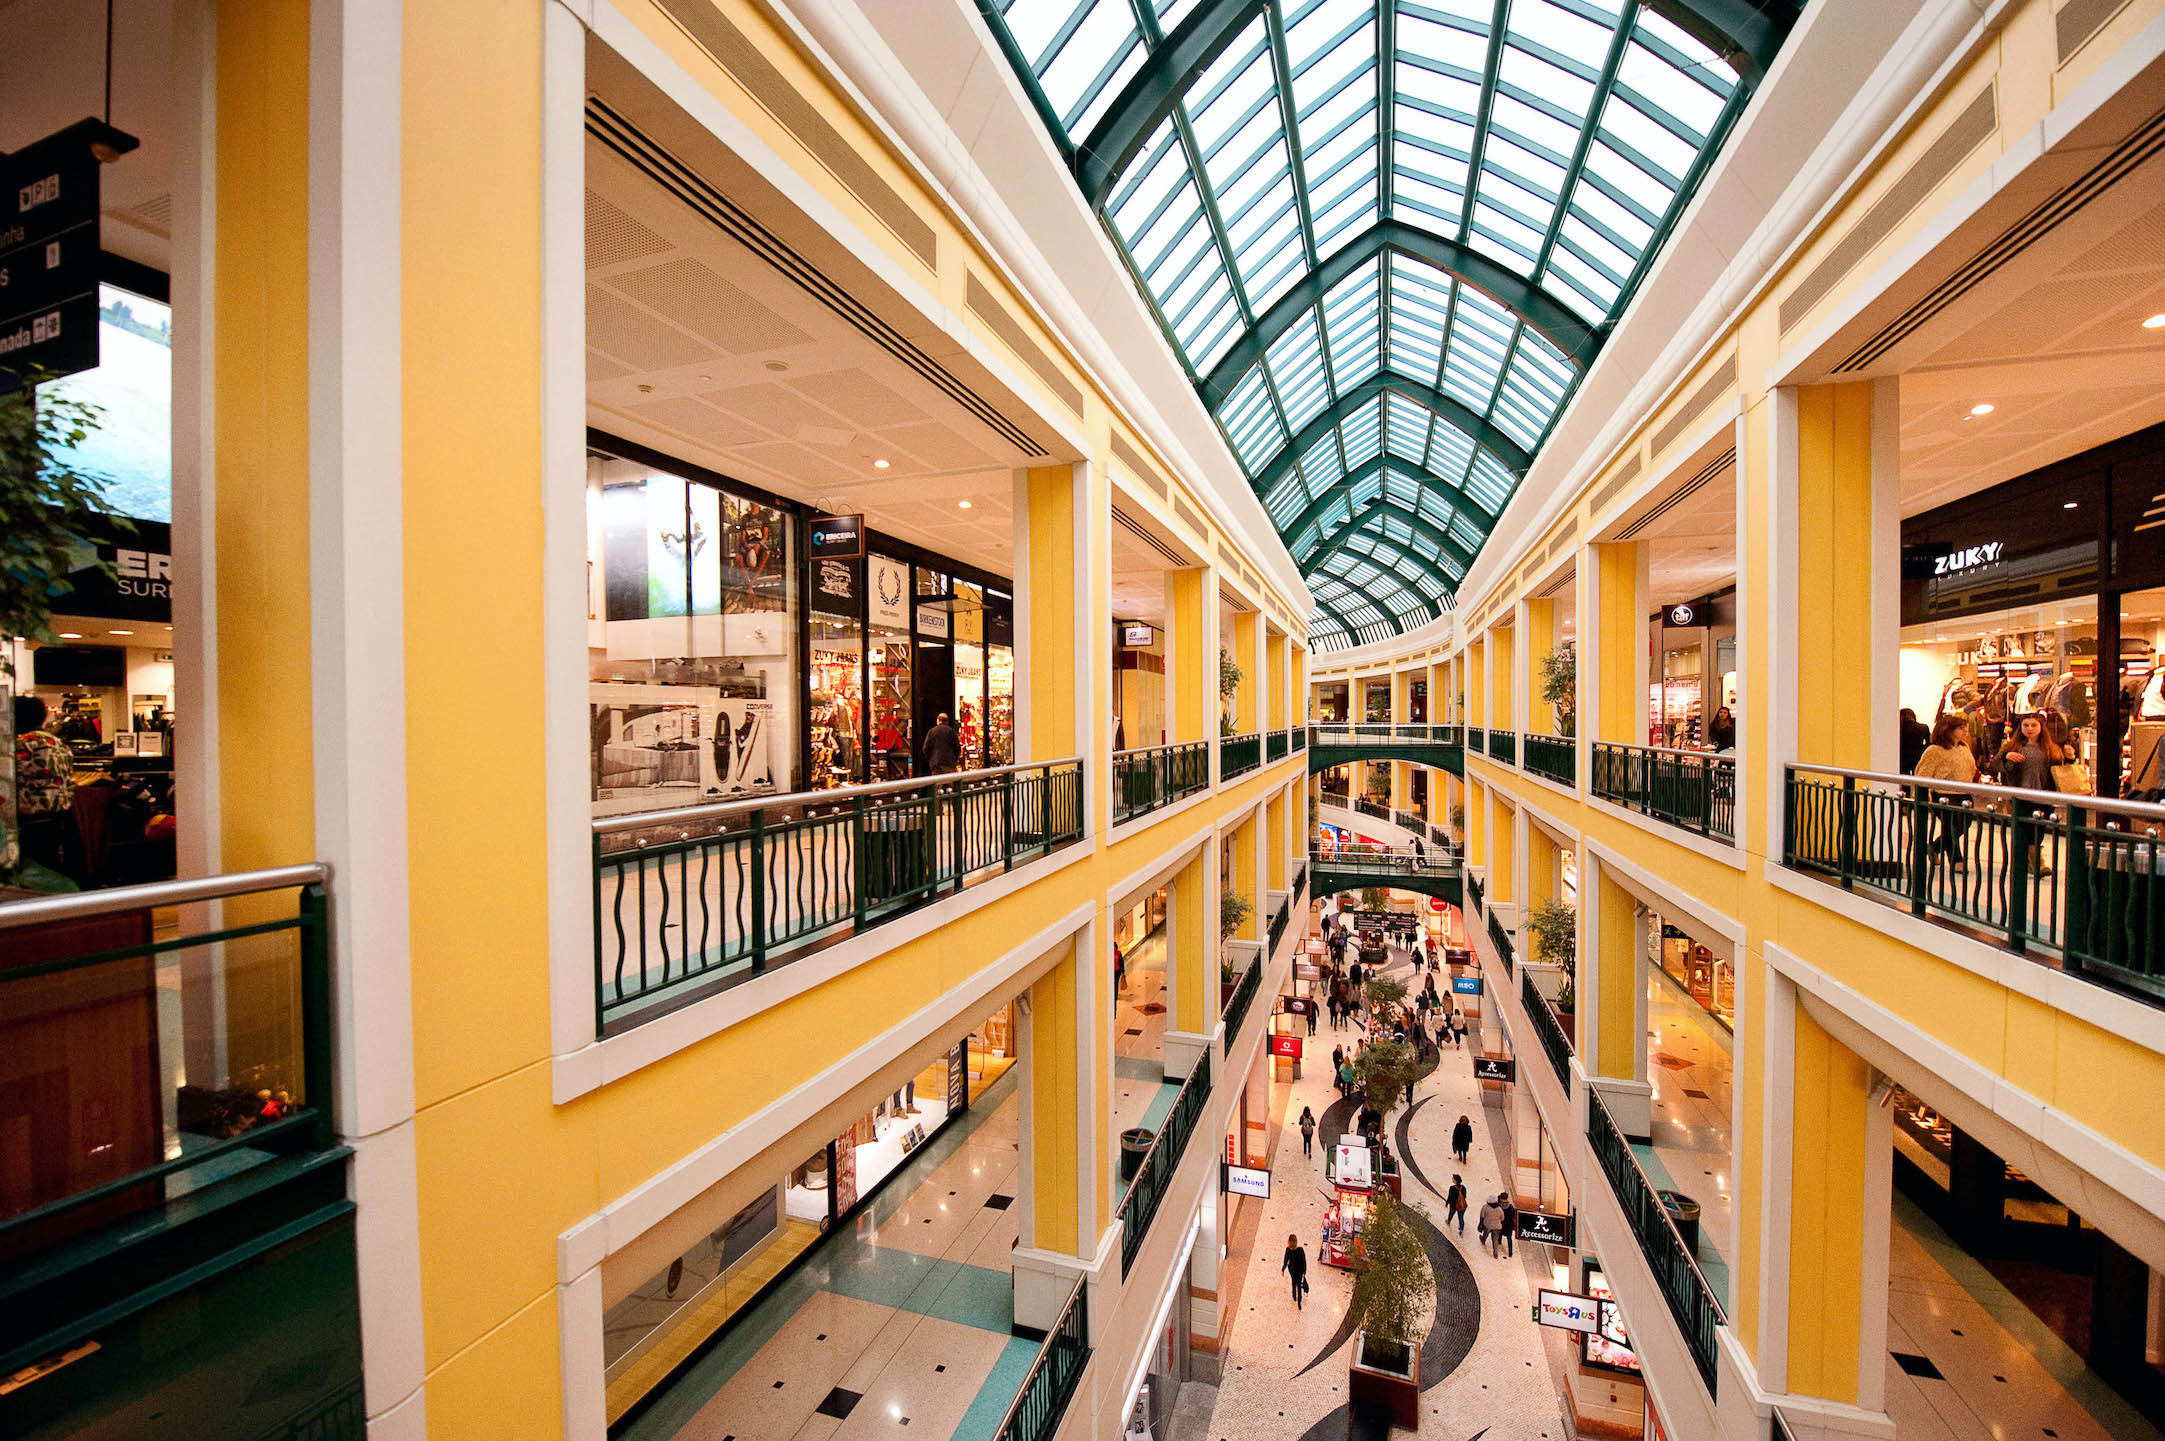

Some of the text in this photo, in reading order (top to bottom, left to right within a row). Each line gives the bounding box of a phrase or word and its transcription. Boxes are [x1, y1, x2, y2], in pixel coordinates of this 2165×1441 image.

[1935, 541, 2004, 575] ZUKY
[1938, 562, 2000, 582] LUXURY
[118, 579, 173, 598] SUR
[1233, 1176, 1265, 1188] SAMSUNG
[1521, 1229, 1563, 1242] Accessorize
